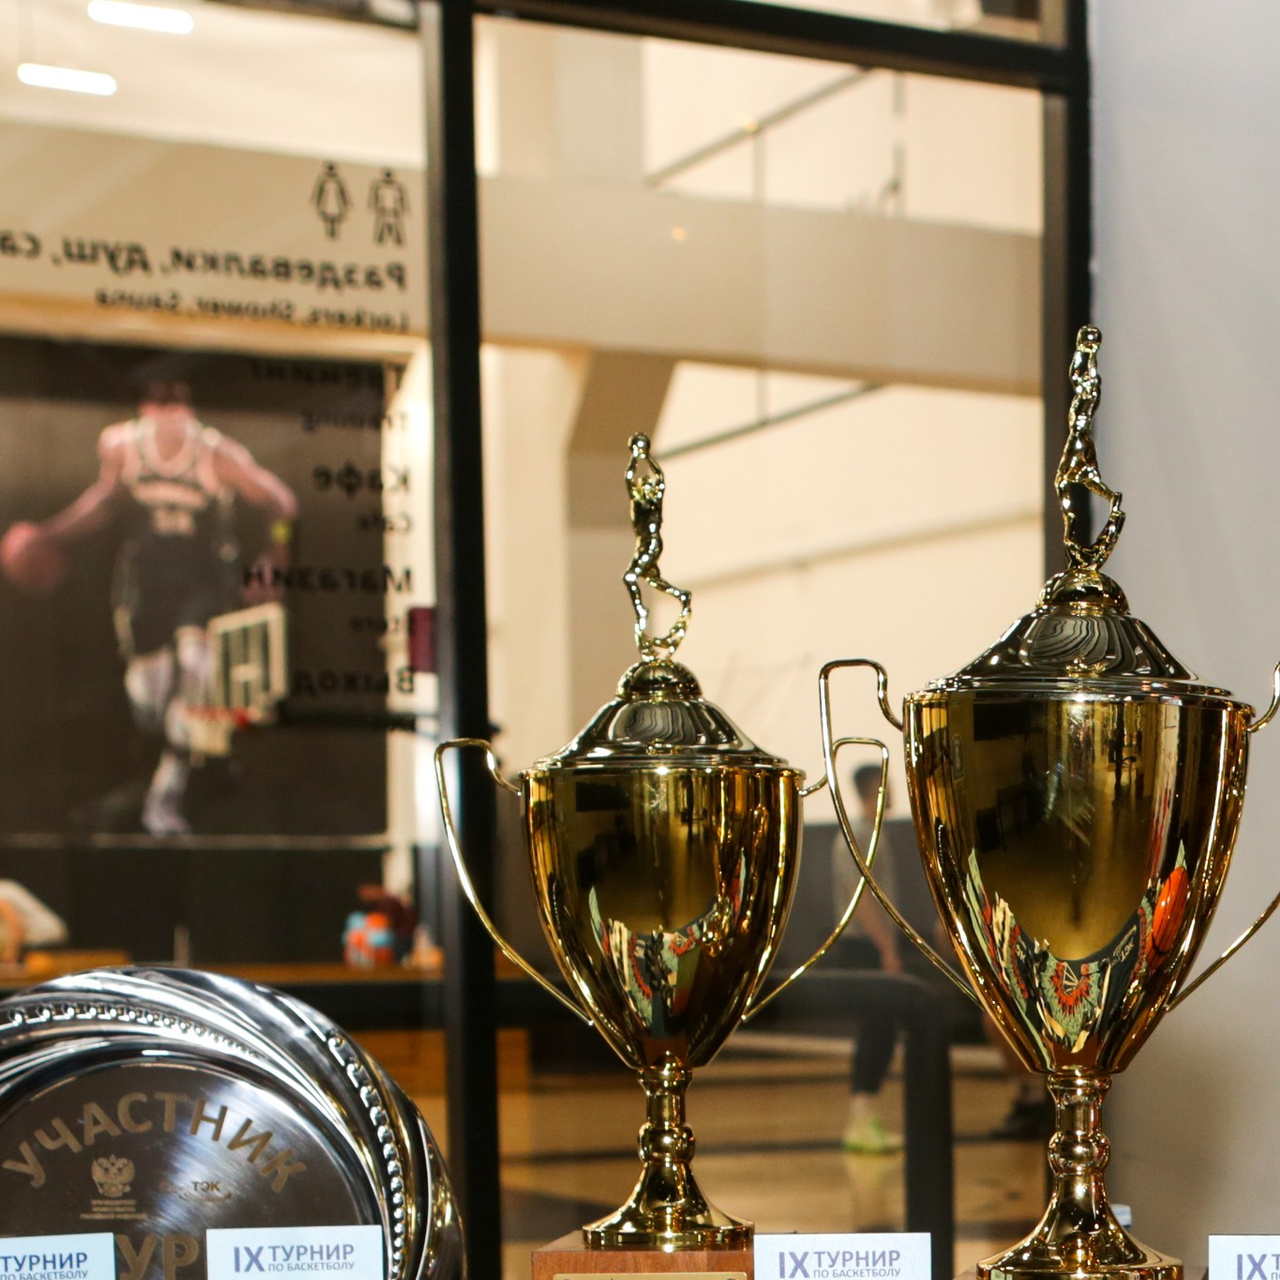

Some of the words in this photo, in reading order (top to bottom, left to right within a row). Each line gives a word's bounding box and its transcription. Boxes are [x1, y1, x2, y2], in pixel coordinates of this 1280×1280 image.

[2, 1092, 307, 1193] УЧАСТНИК
[2, 1252, 89, 1272] ТУРНИР
[233, 1246, 265, 1273] IX
[270, 1244, 355, 1262] ТУРНИР
[268, 1262, 286, 1272] ПО
[289, 1260, 355, 1273] БАСКЕТБОЛУ
[778, 1251, 810, 1279] IX
[812, 1250, 901, 1268] ТУРНИР
[1236, 1253, 1269, 1280] IX
[813, 1268, 829, 1278] ПО
[832, 1268, 901, 1278] БАСКЕТБОЛУ
